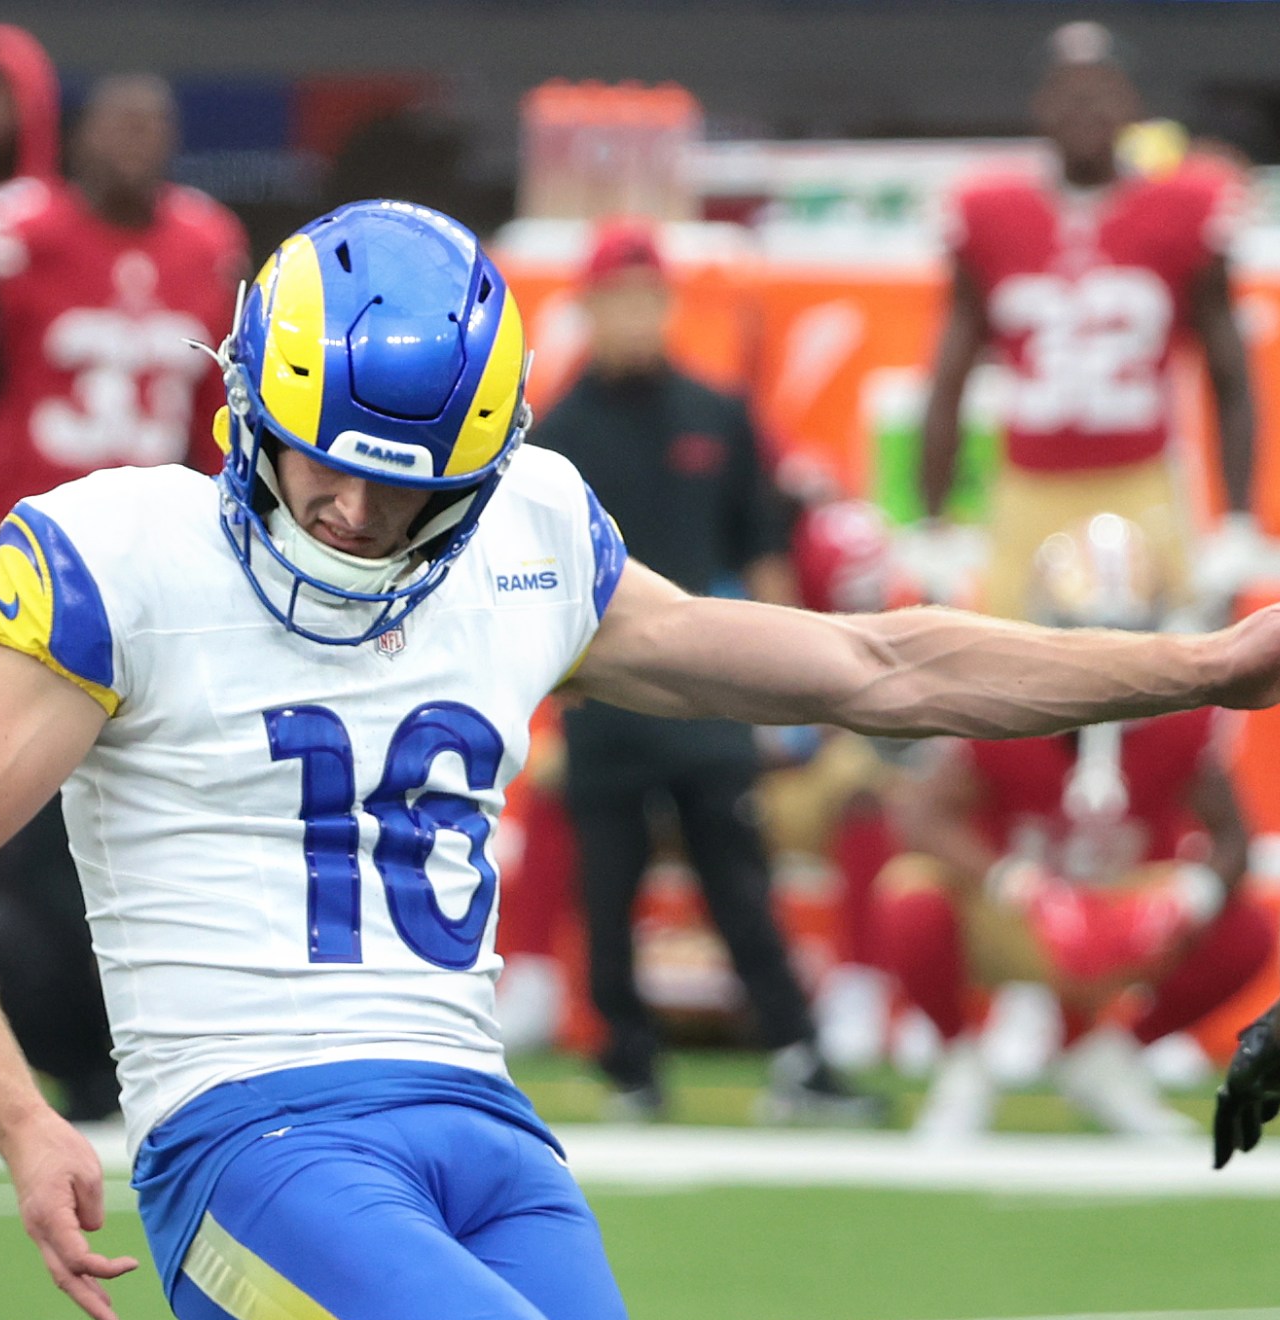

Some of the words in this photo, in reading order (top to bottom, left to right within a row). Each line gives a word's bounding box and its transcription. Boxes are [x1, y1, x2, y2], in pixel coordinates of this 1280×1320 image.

[986, 267, 1174, 432] 32
[355, 440, 416, 468] RAMS
[496, 570, 558, 592] RAMS
[261, 700, 505, 972] 16
